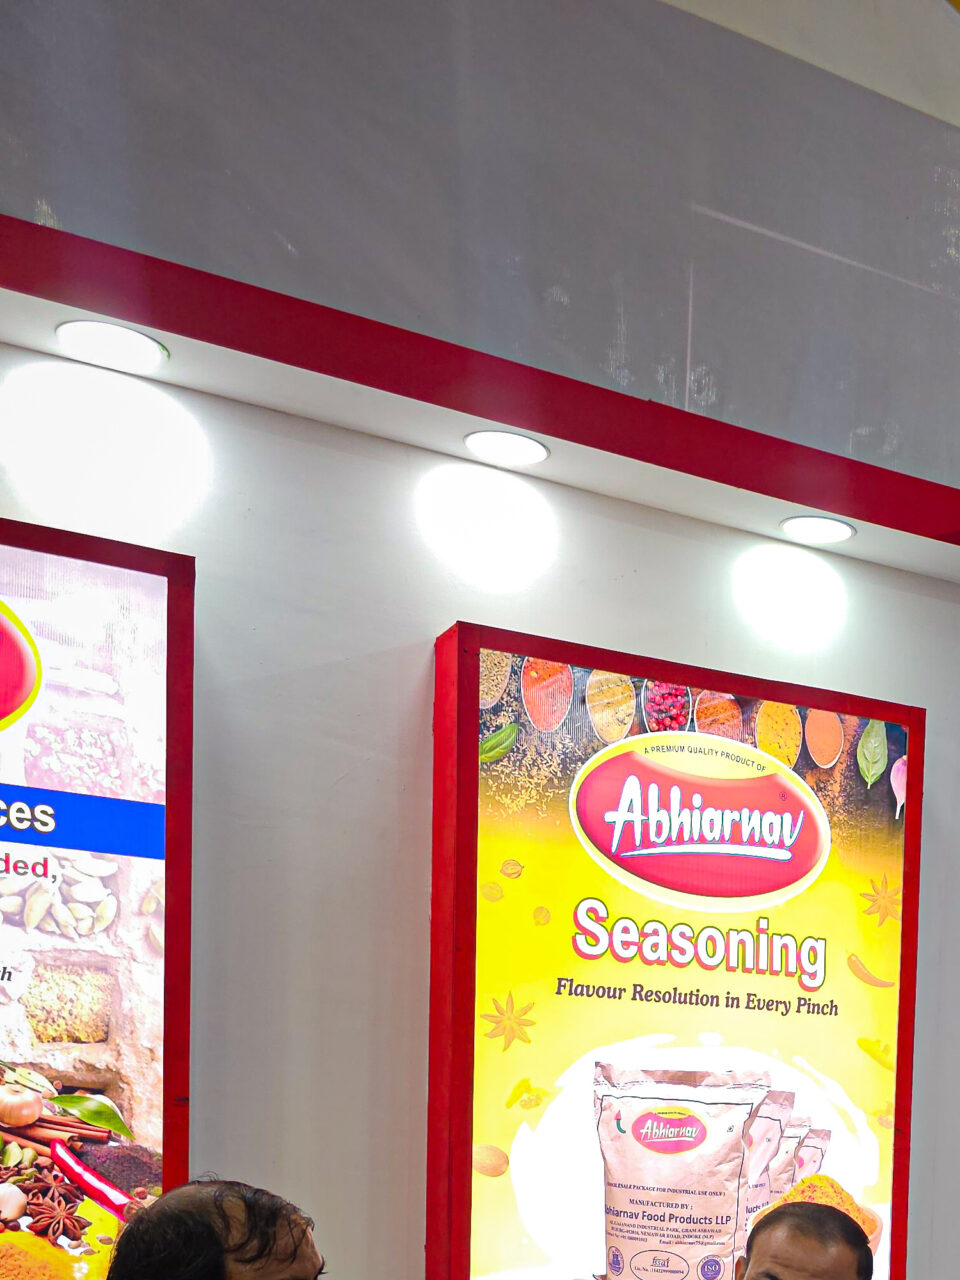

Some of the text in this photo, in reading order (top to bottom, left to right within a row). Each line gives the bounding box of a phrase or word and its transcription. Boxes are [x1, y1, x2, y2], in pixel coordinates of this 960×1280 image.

[644, 745, 767, 772] A PREMIUM QUALITY PRODUCT OF
[603, 774, 805, 854] Abhiarnav
[571, 897, 827, 993] Seasoning
[554, 976, 839, 1017] Flavour Resolution in Every Pinch
[639, 1118, 701, 1141] Abhiarnav
[629, 1198, 680, 1209] MANUFACTURED
[641, 1210, 666, 1223] Food
[668, 1212, 713, 1225] Products
[715, 1215, 731, 1225] LLP
